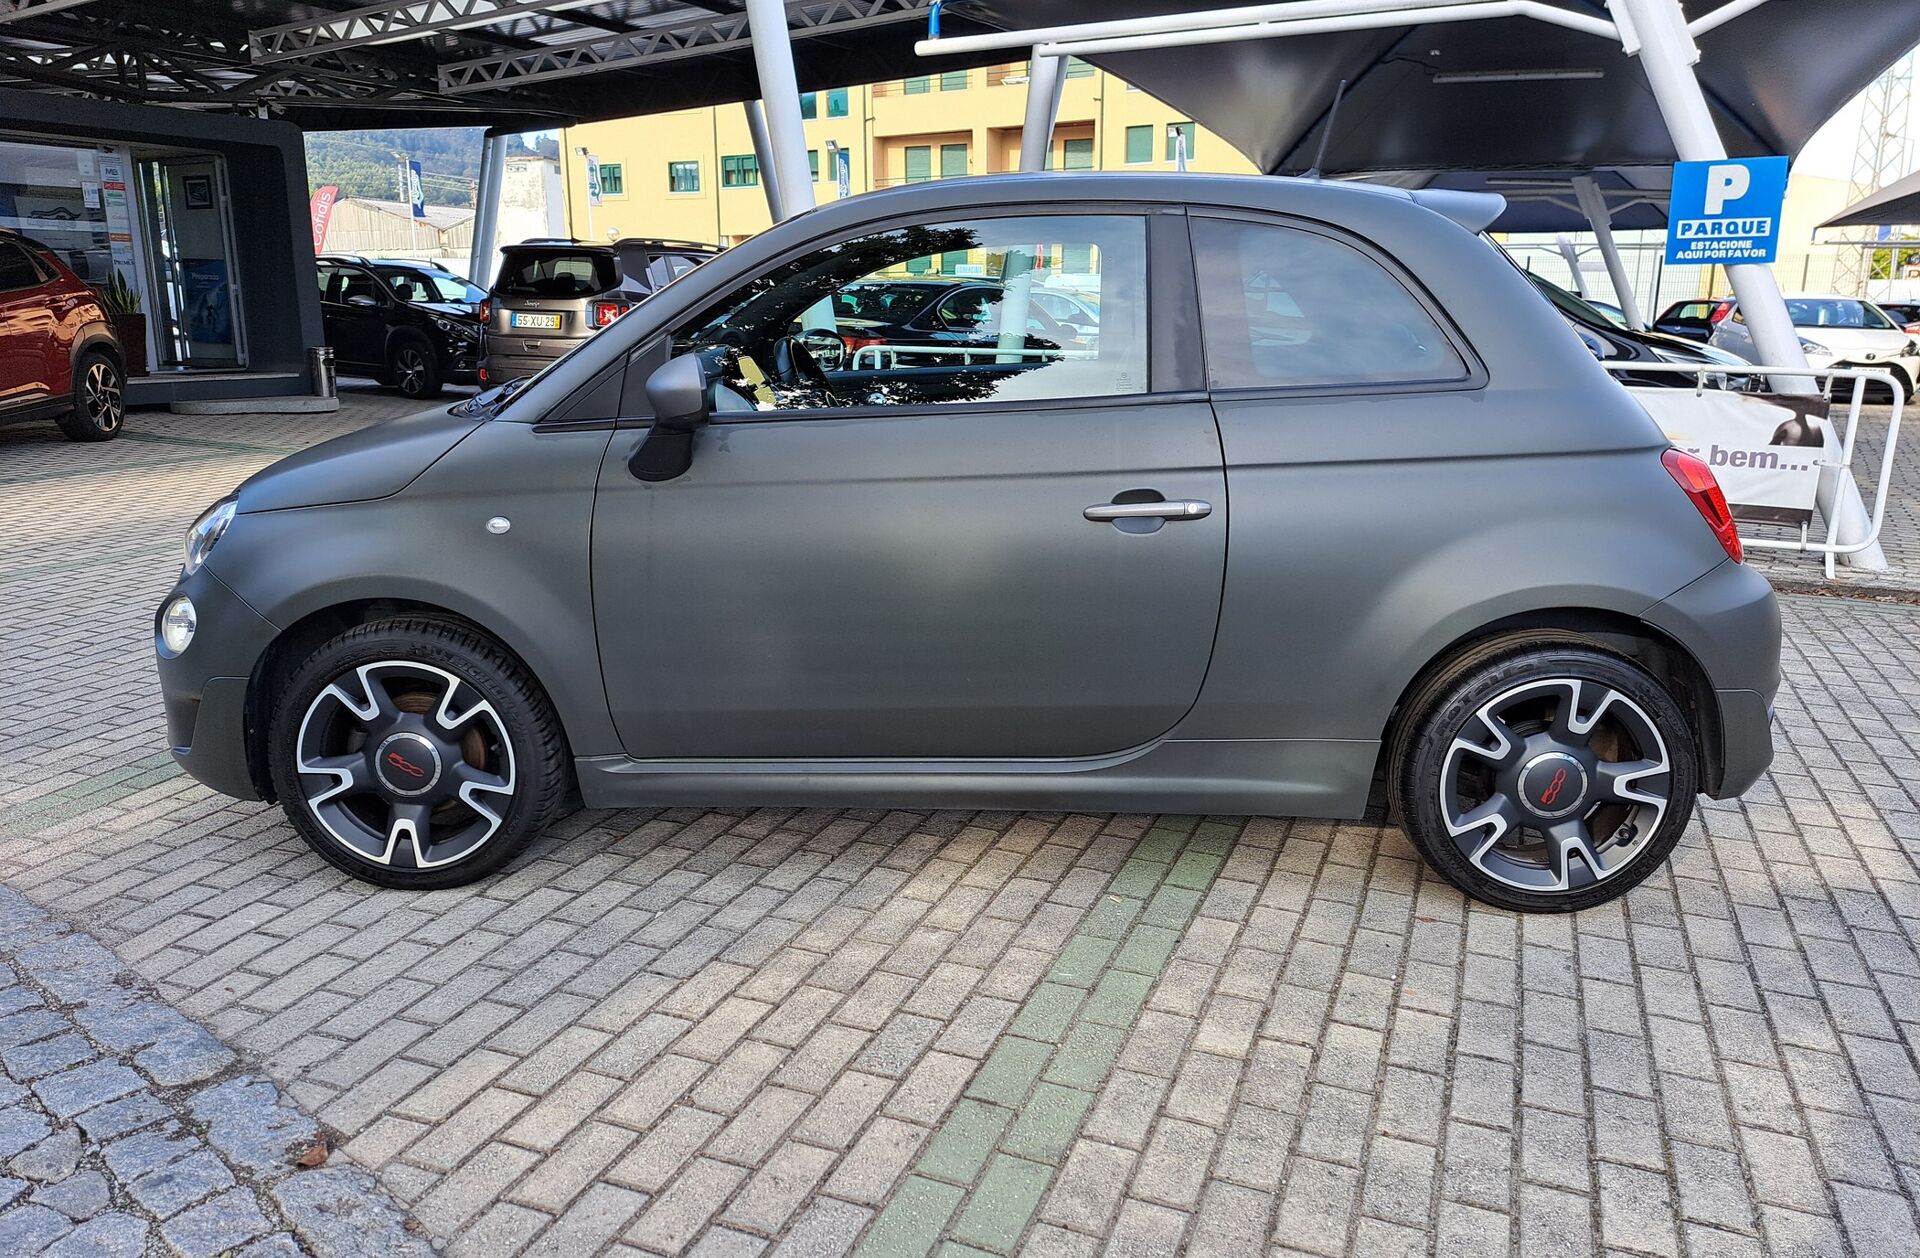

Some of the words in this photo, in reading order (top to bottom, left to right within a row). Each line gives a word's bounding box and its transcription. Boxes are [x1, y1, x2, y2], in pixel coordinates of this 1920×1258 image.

[1704, 164, 1750, 215] P
[1680, 220, 1767, 236] PARQUE
[1690, 240, 1753, 250] ESTACIONE
[1675, 250, 1703, 259] AQUI
[1704, 249, 1726, 258] POR
[1727, 249, 1766, 258] FAVOR
[1709, 444, 1808, 471] bem...
